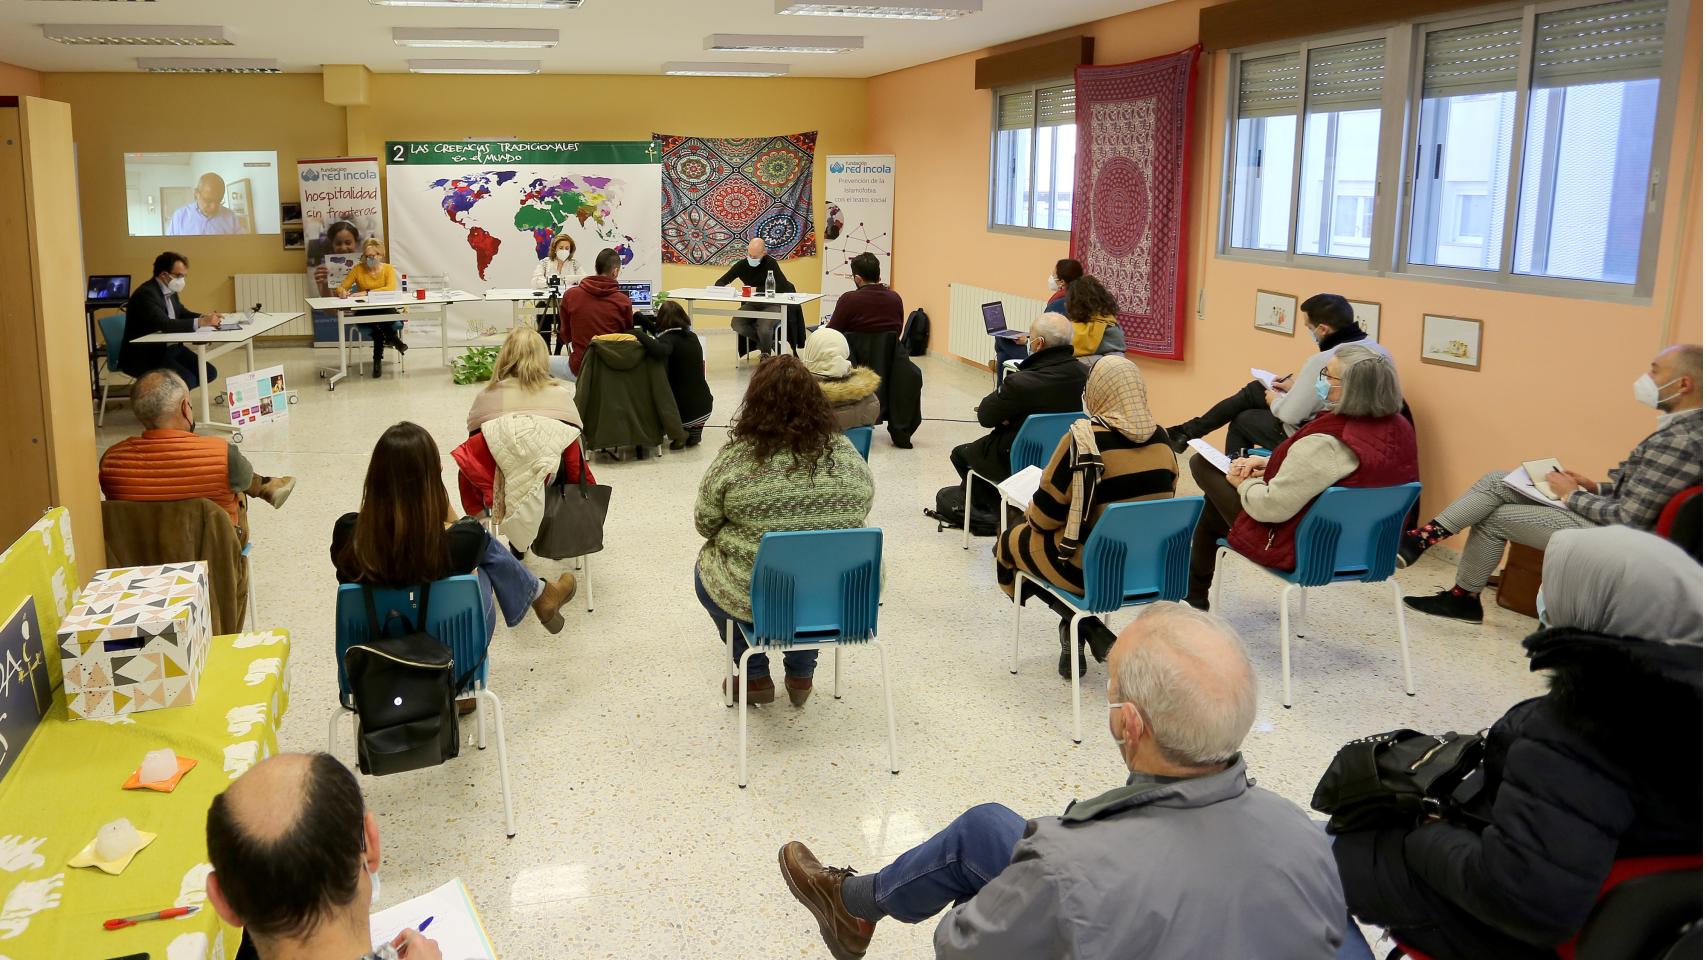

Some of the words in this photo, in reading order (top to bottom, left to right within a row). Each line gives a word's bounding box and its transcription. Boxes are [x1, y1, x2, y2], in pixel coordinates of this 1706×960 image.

[393, 145, 405, 161] 2
[410, 143, 429, 154] LAS
[434, 143, 490, 154] CREENCIAS
[497, 143, 580, 152] TRADICIONALES
[469, 151, 482, 163] el
[482, 154, 522, 164] MUNDO
[845, 165, 861, 173] red
[864, 164, 892, 173] incola
[321, 171, 341, 180] red
[343, 170, 377, 180] incola
[304, 186, 378, 206] hospitalidad
[306, 207, 322, 218] sin
[326, 206, 377, 218] fronteras
